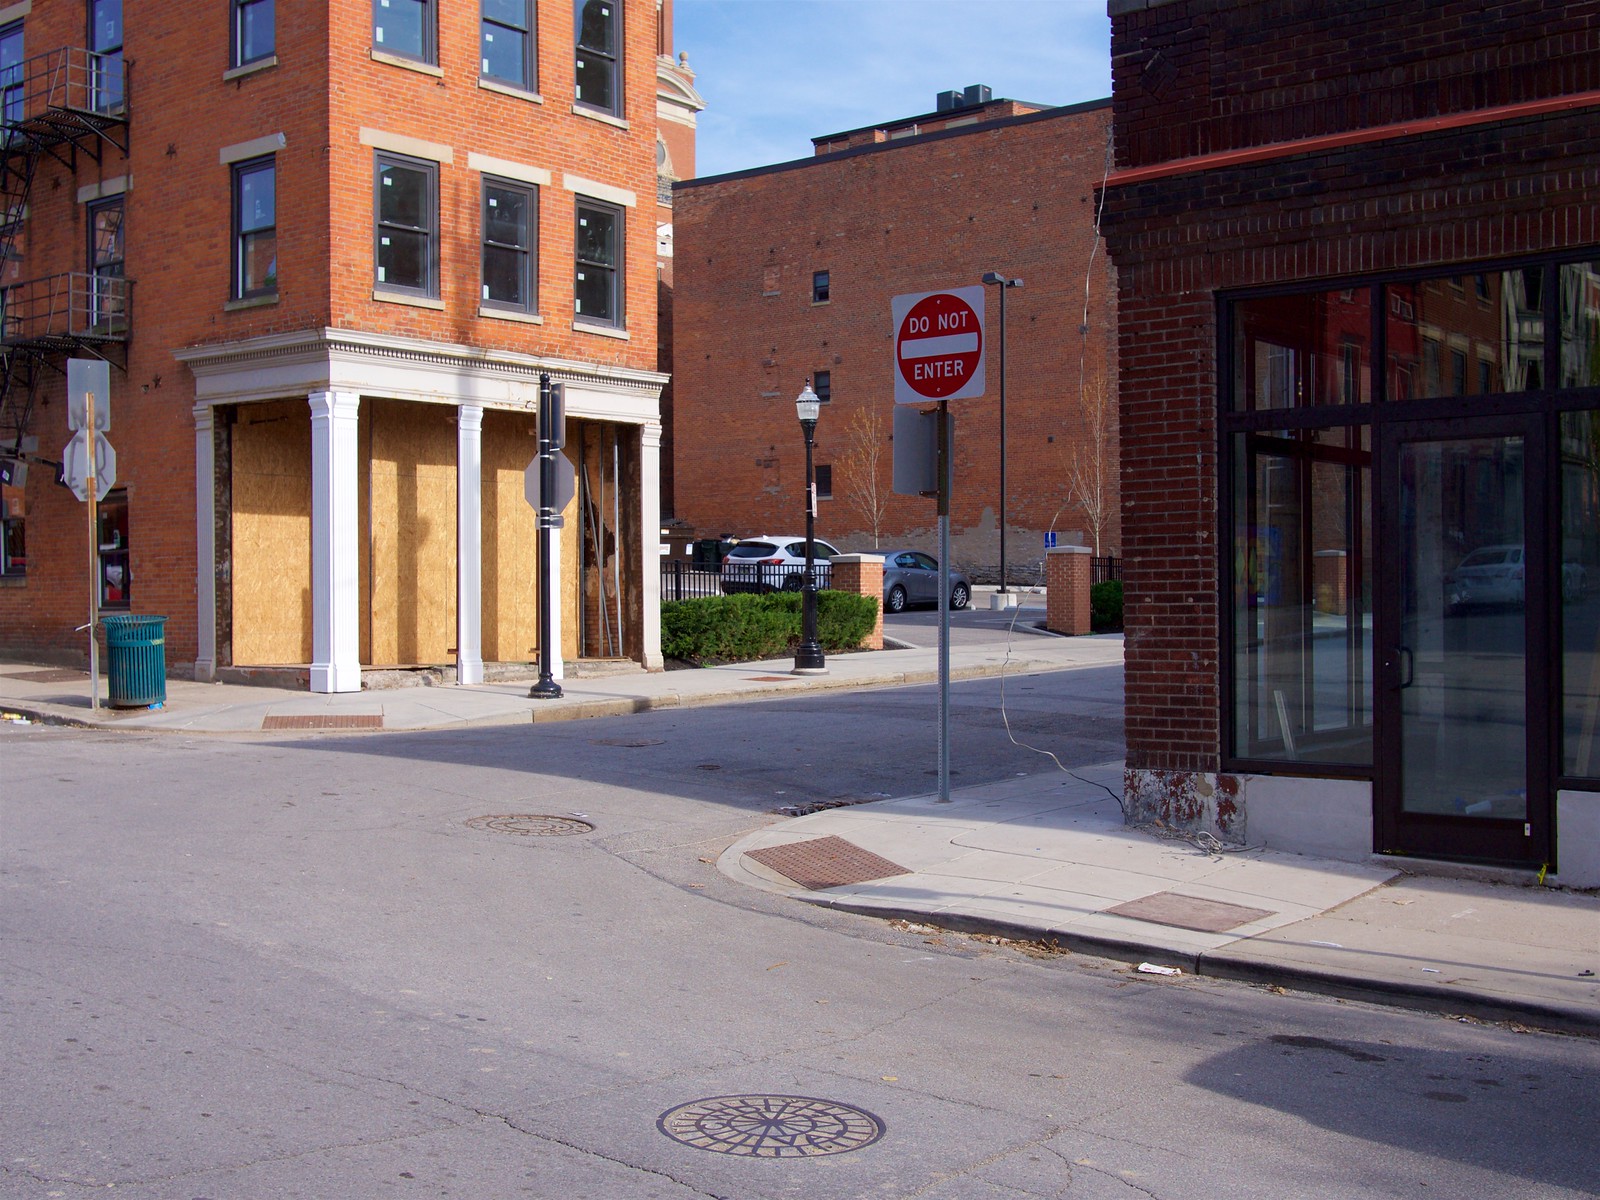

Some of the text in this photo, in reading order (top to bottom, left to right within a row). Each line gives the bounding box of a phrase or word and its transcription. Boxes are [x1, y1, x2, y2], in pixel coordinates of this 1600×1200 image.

[909, 310, 969, 334] DO NOT
[914, 360, 964, 380] ENTER
